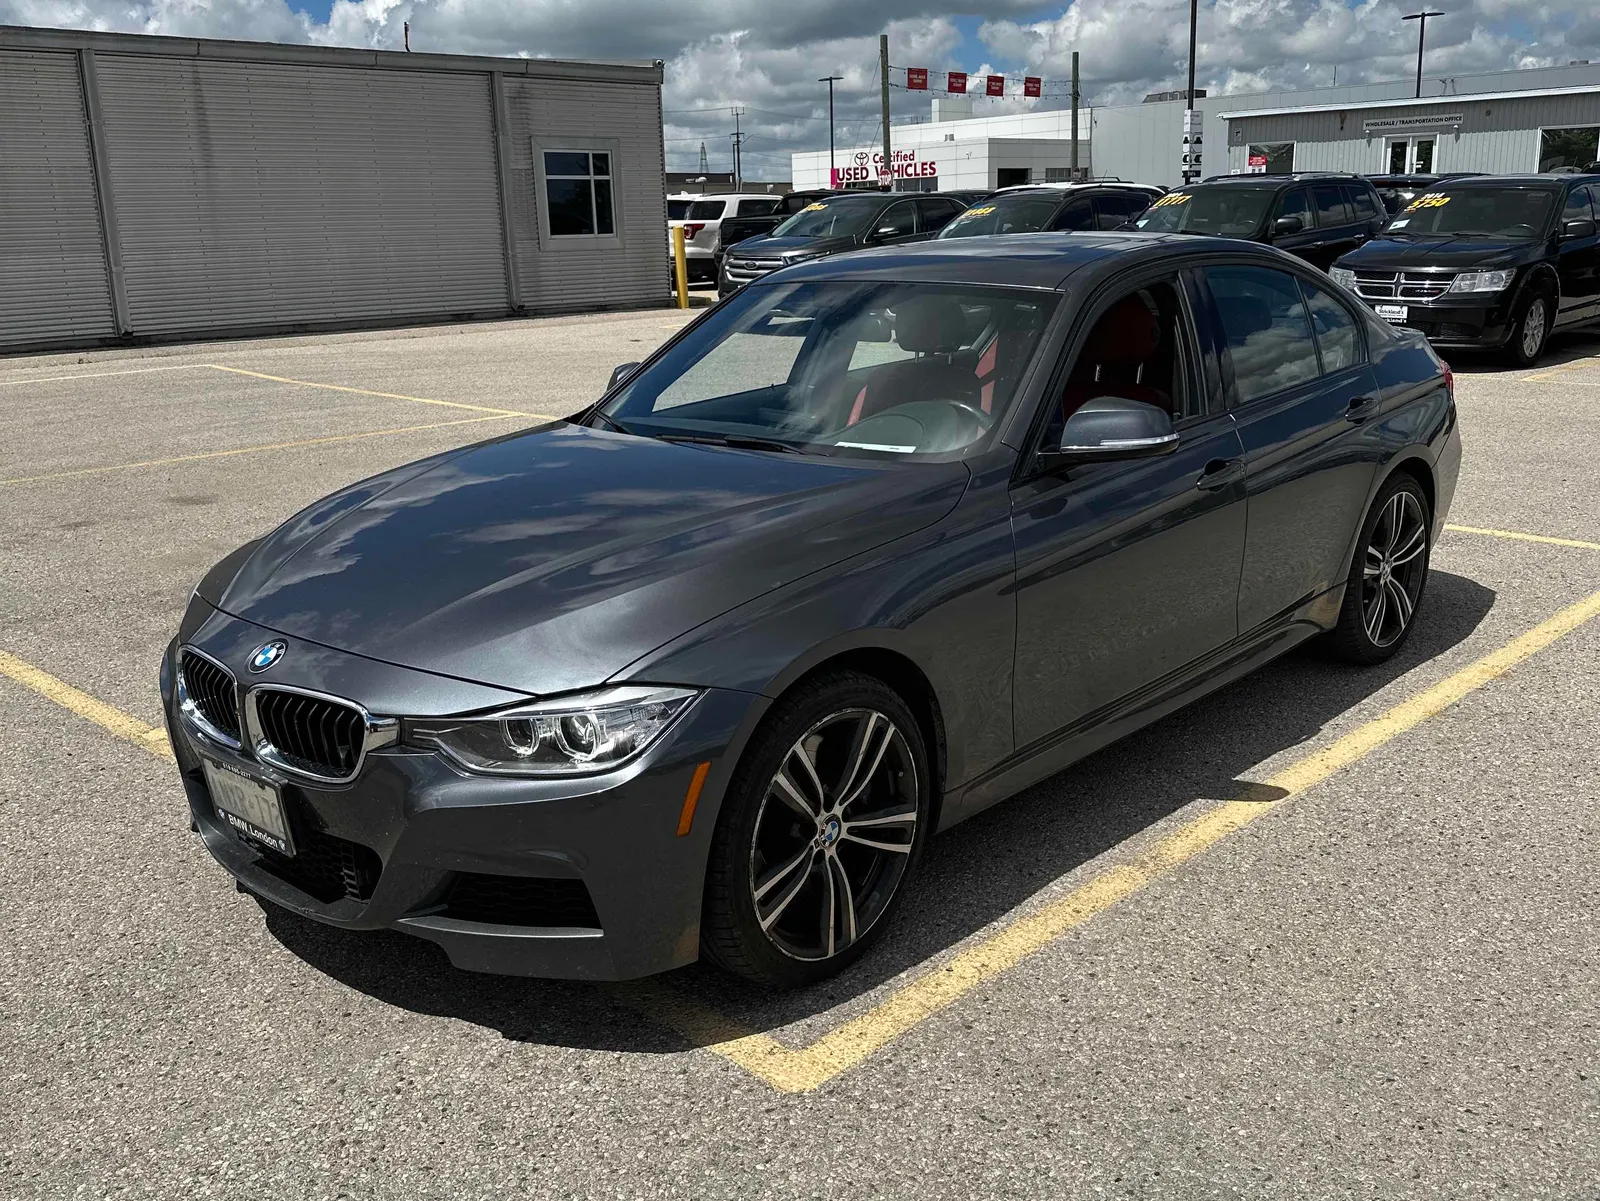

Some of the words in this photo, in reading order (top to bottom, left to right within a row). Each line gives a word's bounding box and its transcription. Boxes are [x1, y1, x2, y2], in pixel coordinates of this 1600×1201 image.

[1399, 117, 1444, 125] TRANSPORTATION
[873, 150, 915, 164] Cetified
[836, 167, 869, 182] USED
[874, 161, 937, 180] VHICLES
[879, 175, 891, 186] STOP
[228, 813, 248, 832] BMW
[249, 824, 278, 848] London
